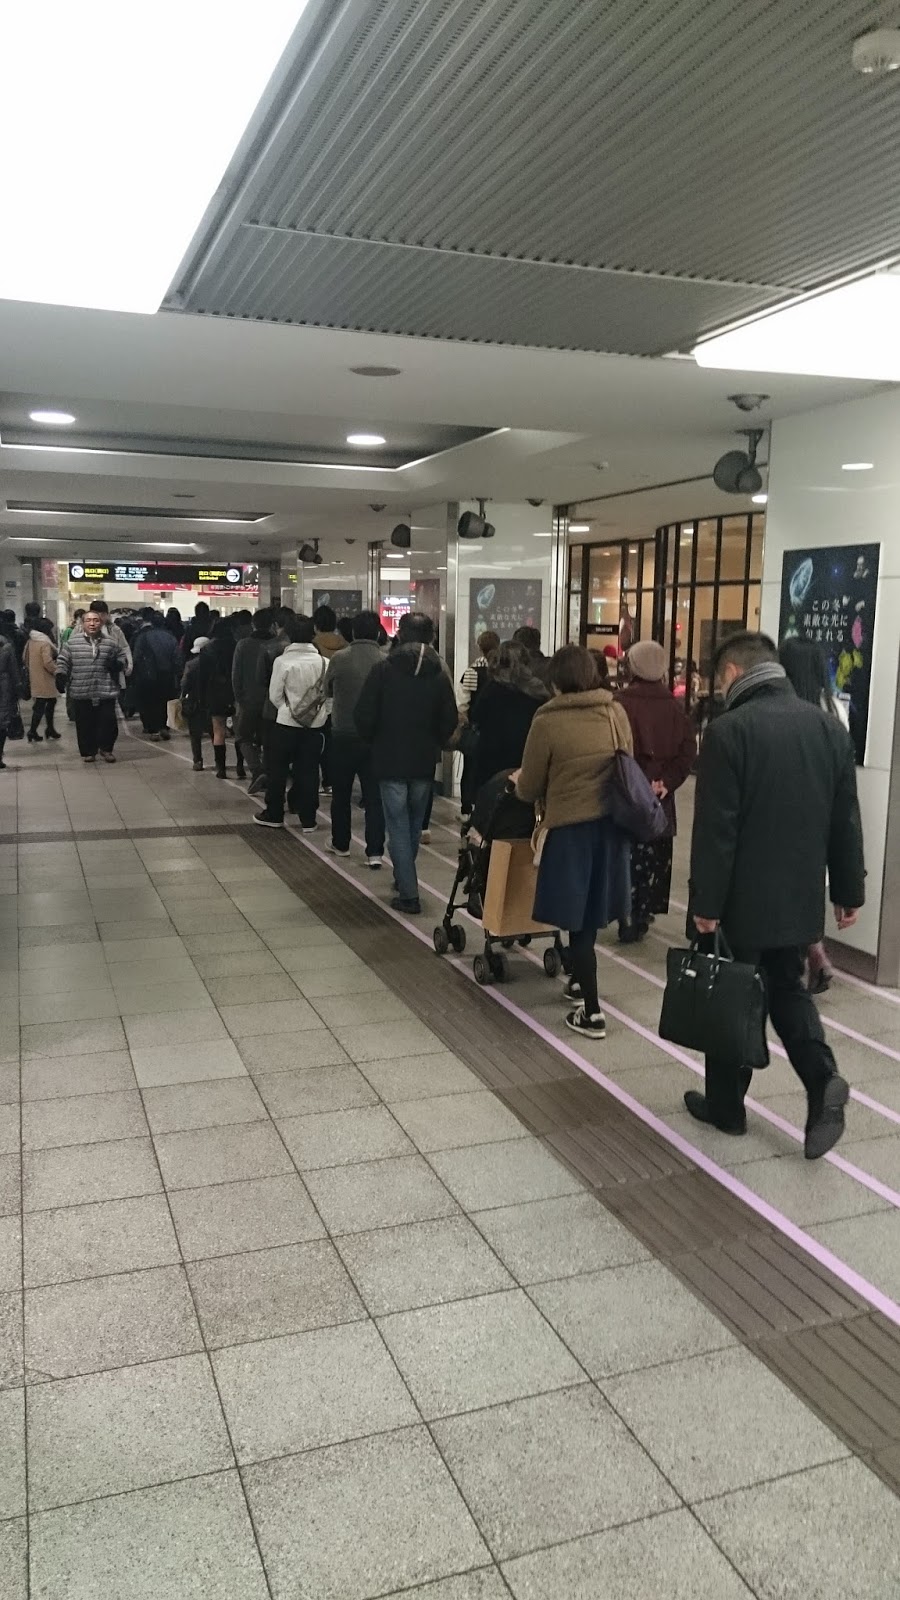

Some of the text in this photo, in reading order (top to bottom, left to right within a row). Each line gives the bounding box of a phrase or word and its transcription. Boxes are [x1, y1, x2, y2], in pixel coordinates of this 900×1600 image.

[812, 598, 841, 612] この冬
[803, 613, 848, 627] 素敵な光に
[806, 629, 844, 642] 包まれる
